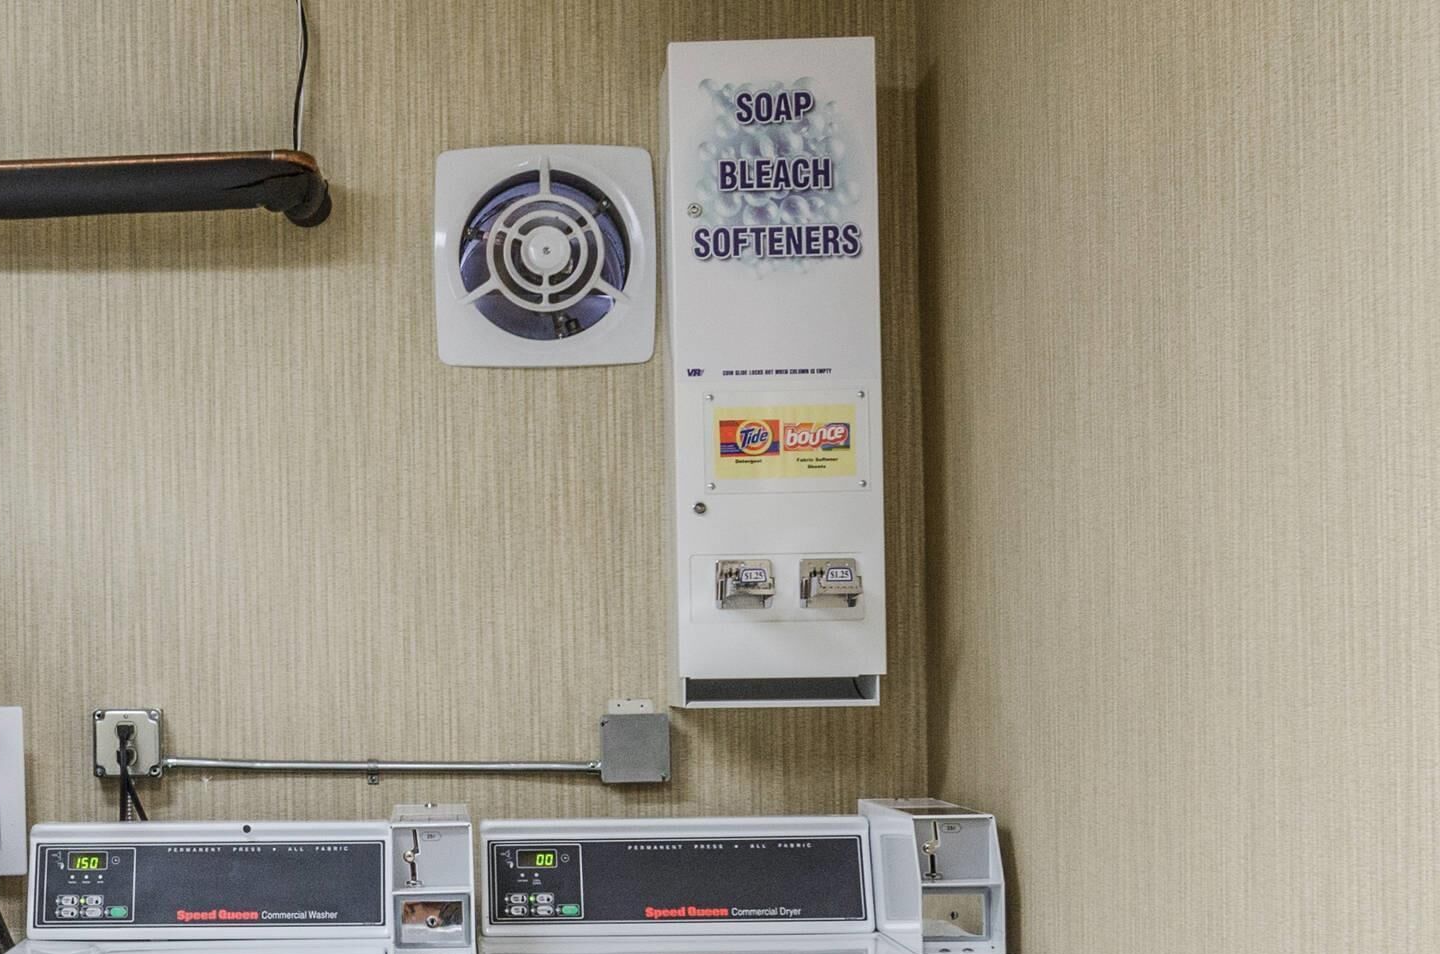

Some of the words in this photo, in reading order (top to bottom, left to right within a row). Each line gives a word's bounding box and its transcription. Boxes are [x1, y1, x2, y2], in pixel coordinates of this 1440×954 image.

[736, 91, 815, 124] SOAP
[719, 158, 833, 191] BLEACH
[694, 225, 860, 259] SOFTENERS
[740, 427, 768, 449] Tide
[786, 426, 845, 447] bounce
[744, 571, 763, 580] $1.25
[829, 570, 849, 579] $1.25
[76, 857, 99, 869] 150
[536, 854, 553, 866] 00
[176, 909, 217, 922] Speed
[218, 909, 259, 920] Queen
[261, 910, 308, 920] Commercial
[308, 910, 338, 920] Washer
[645, 907, 686, 919] Speed
[687, 907, 728, 917] Queen
[731, 907, 778, 916] Commercial
[779, 907, 802, 918] Dryer
